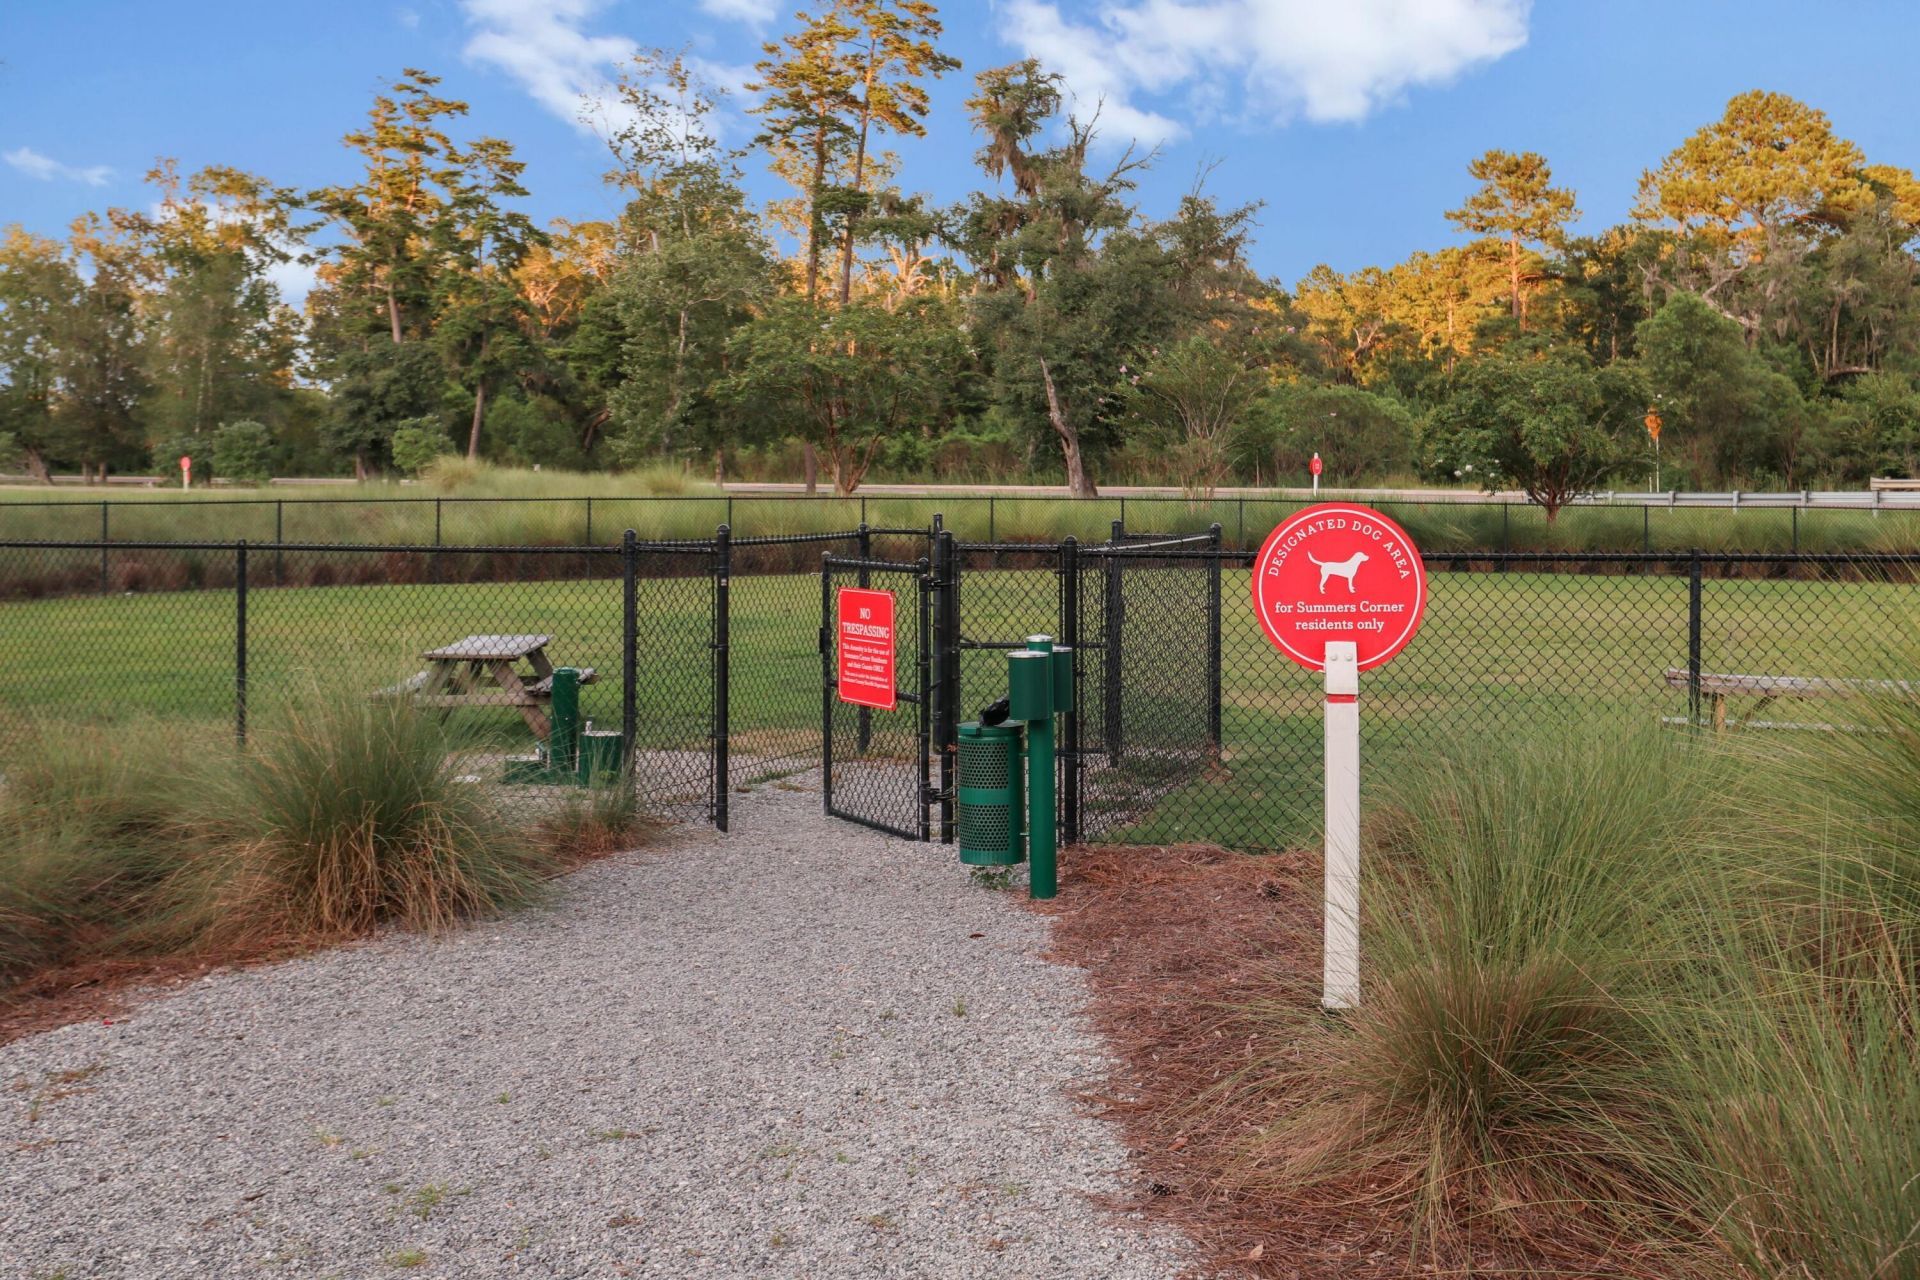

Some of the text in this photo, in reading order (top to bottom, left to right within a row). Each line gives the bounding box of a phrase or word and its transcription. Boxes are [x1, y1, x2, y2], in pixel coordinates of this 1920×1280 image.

[1269, 518, 1411, 580] DESIGNATED DOG AREA
[859, 607, 871, 620] NO
[1275, 601, 1405, 613] for Summers Corner
[842, 621, 890, 639] TRESPASSING
[1296, 618, 1385, 633] residents only
